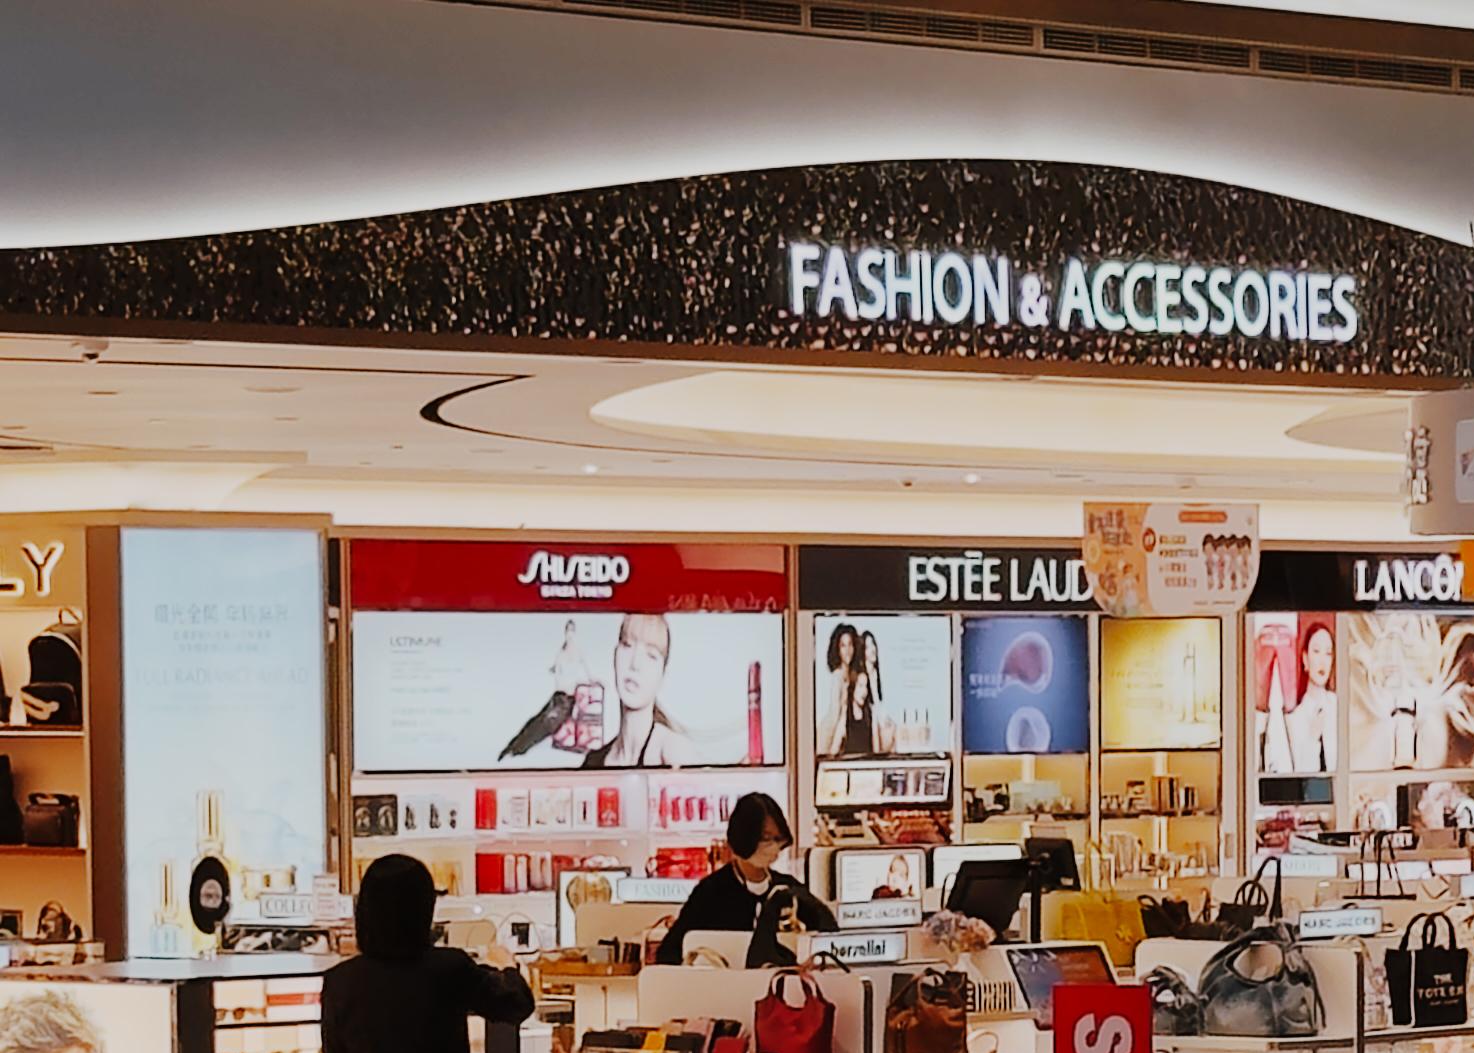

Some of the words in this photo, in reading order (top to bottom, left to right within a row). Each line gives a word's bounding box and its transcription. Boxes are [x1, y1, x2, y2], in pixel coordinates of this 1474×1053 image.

[789, 243, 1010, 325] FASHION
[1018, 272, 1049, 328] &
[1058, 258, 1357, 342] ACCESSORIES
[517, 550, 630, 584] SHISEIDO
[1010, 558, 1093, 602] LAUD
[1354, 554, 1465, 601] LANCÔ
